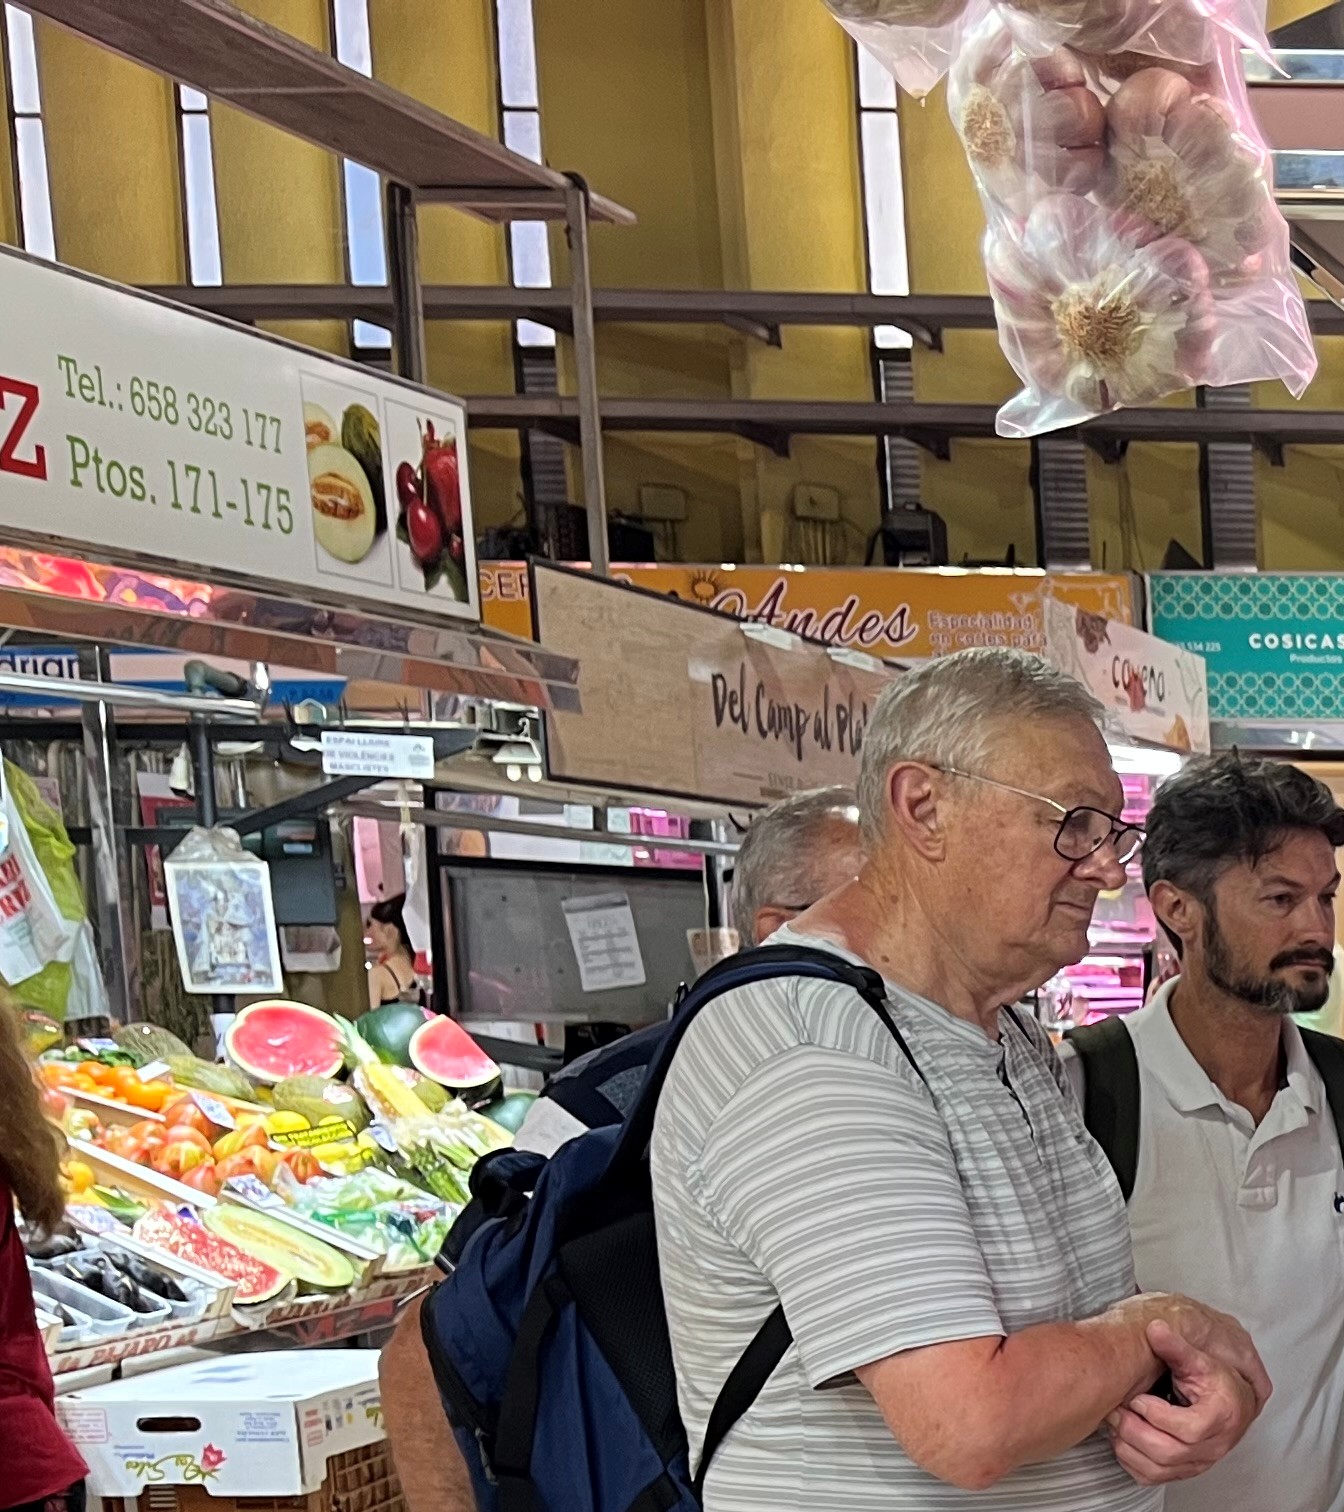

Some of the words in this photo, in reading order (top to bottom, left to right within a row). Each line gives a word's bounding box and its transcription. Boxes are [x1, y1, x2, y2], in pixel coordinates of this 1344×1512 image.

[57, 354, 124, 412] Tel.:
[130, 375, 180, 426] 658
[187, 392, 234, 441] 323
[242, 407, 283, 455] 177
[66, 433, 157, 506] Ptos.
[167, 458, 294, 535] 171-175
[1290, 653, 1343, 664] Productos
[711, 661, 748, 734] Del
[755, 680, 810, 762] Camp
[814, 683, 831, 751] al
